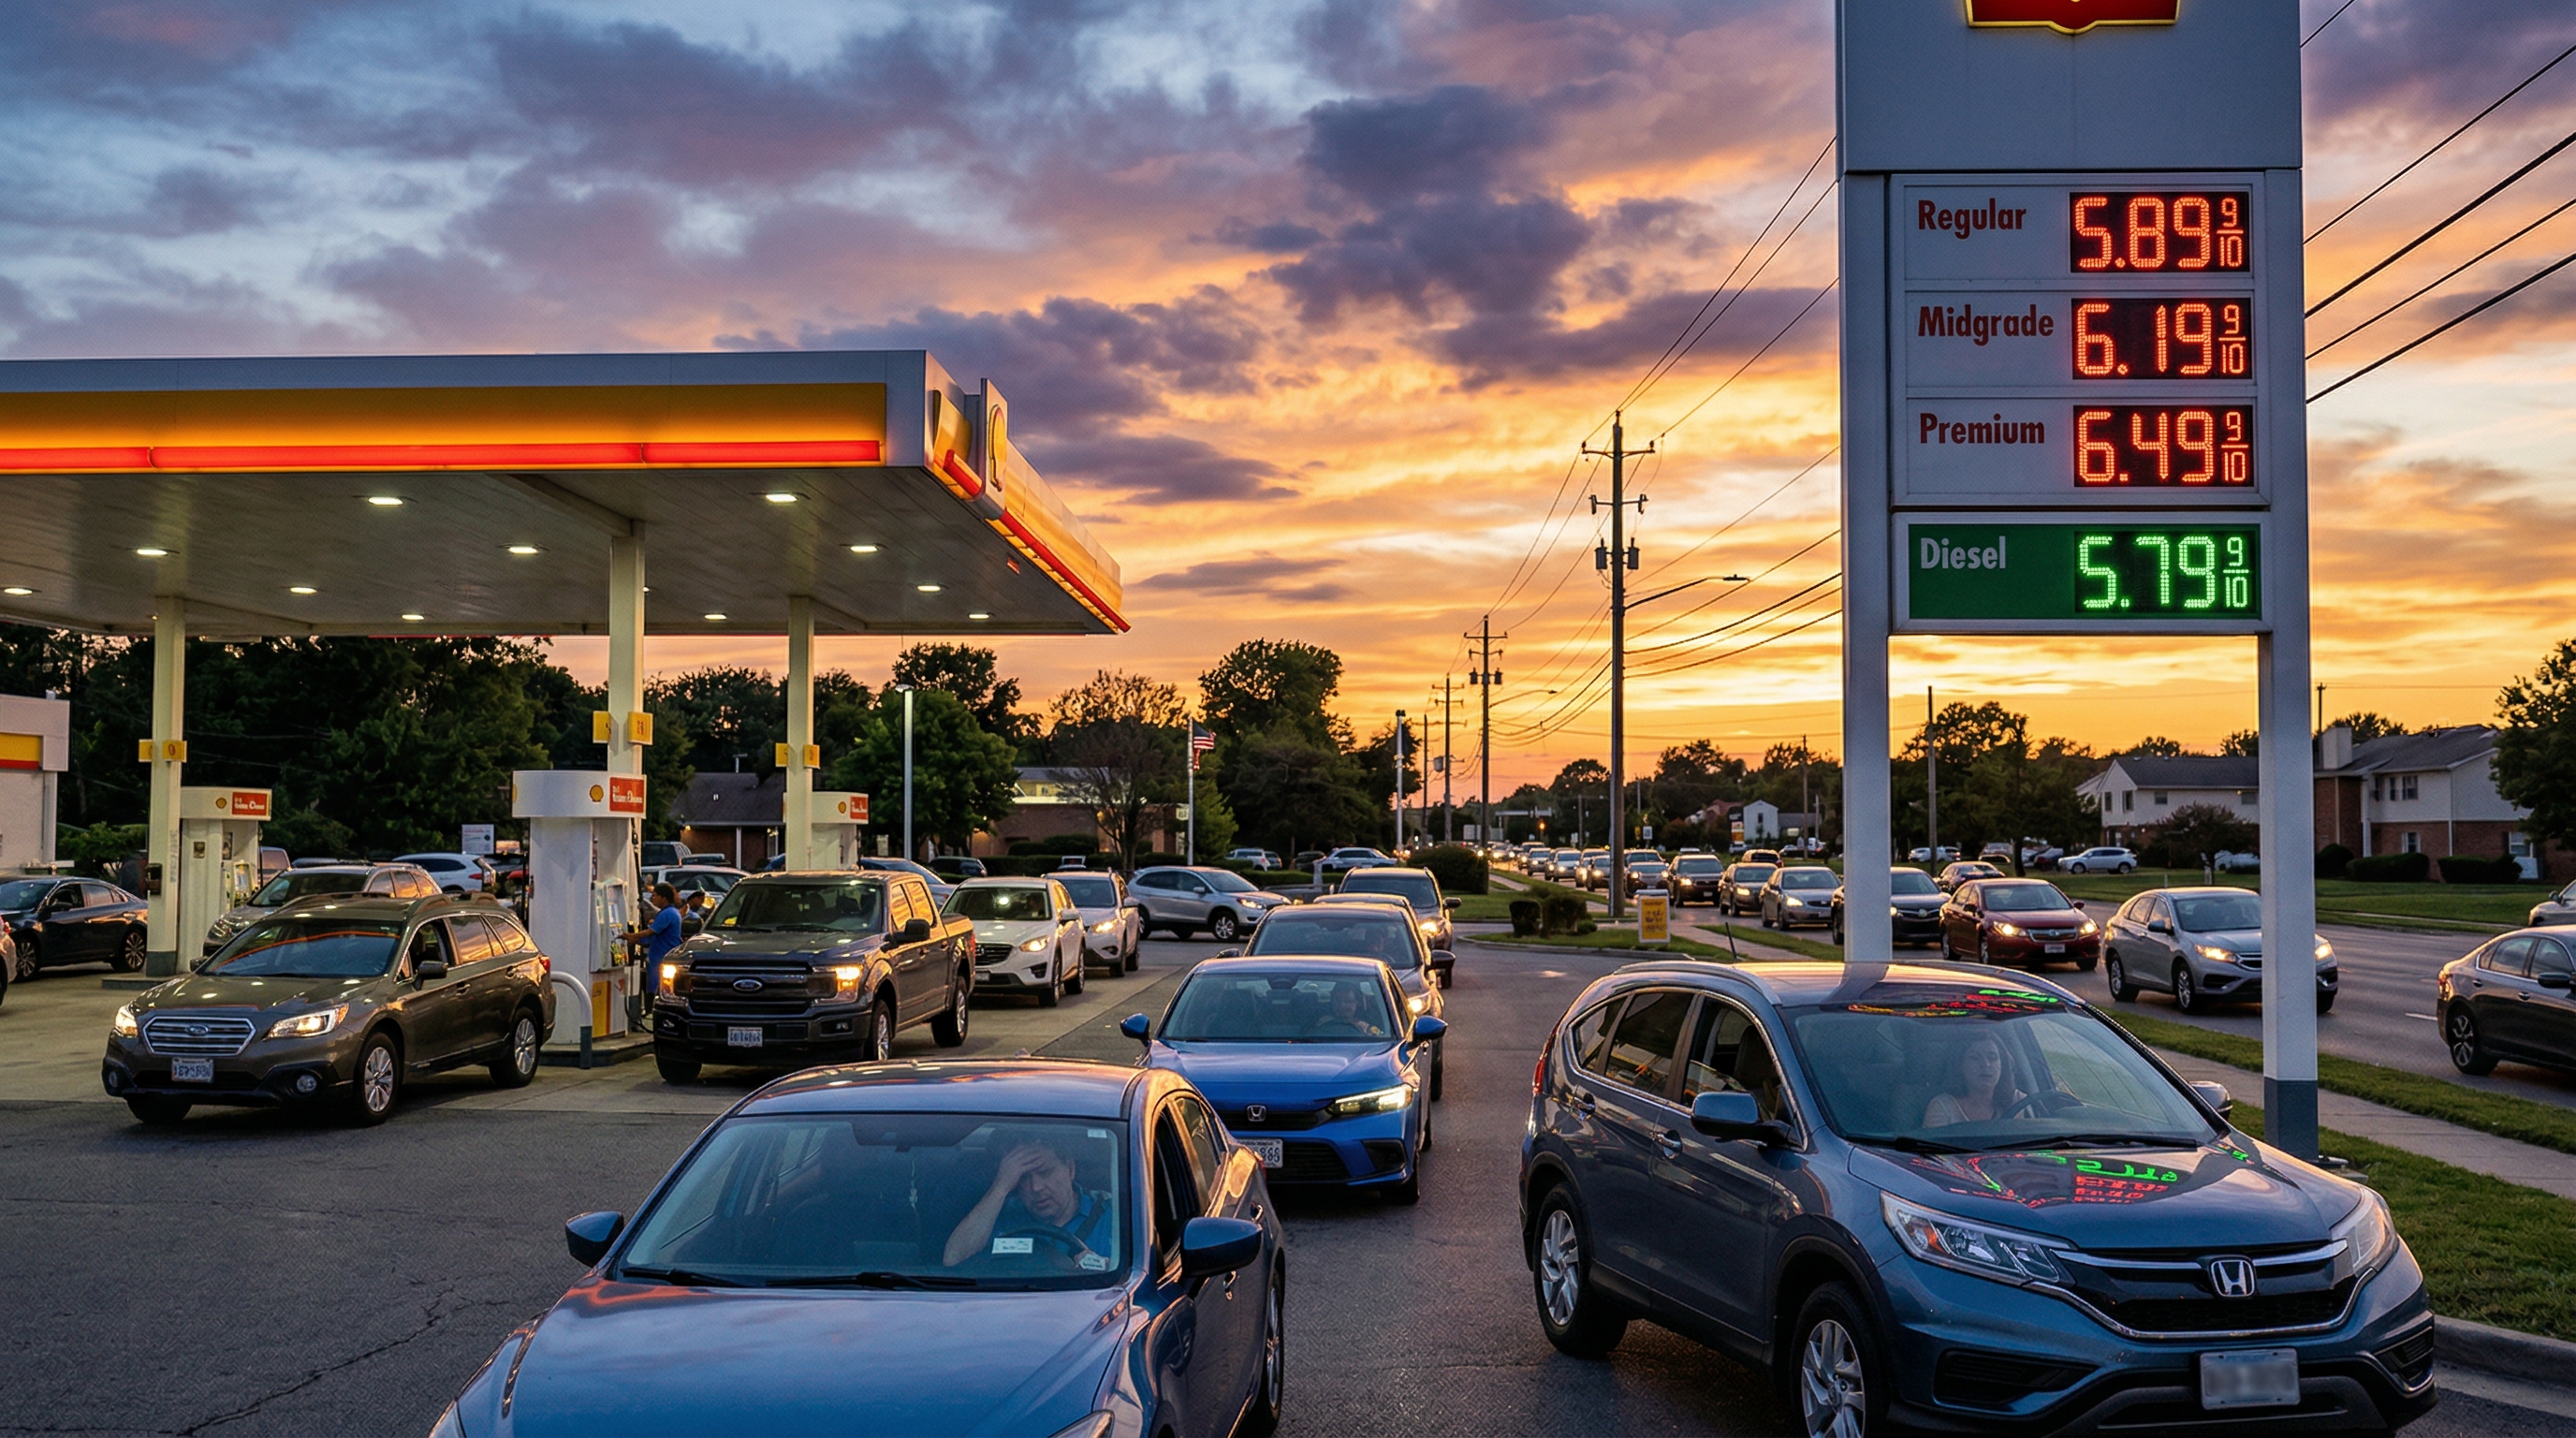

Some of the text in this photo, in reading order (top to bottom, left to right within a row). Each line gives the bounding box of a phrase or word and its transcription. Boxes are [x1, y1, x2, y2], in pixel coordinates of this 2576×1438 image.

[1918, 197, 2211, 268] Regular 5.89
[1918, 302, 2212, 374] Midgrade 6.19
[1920, 410, 2215, 482] Premium 6.49
[1921, 536, 2216, 608] Diesel 5.79
